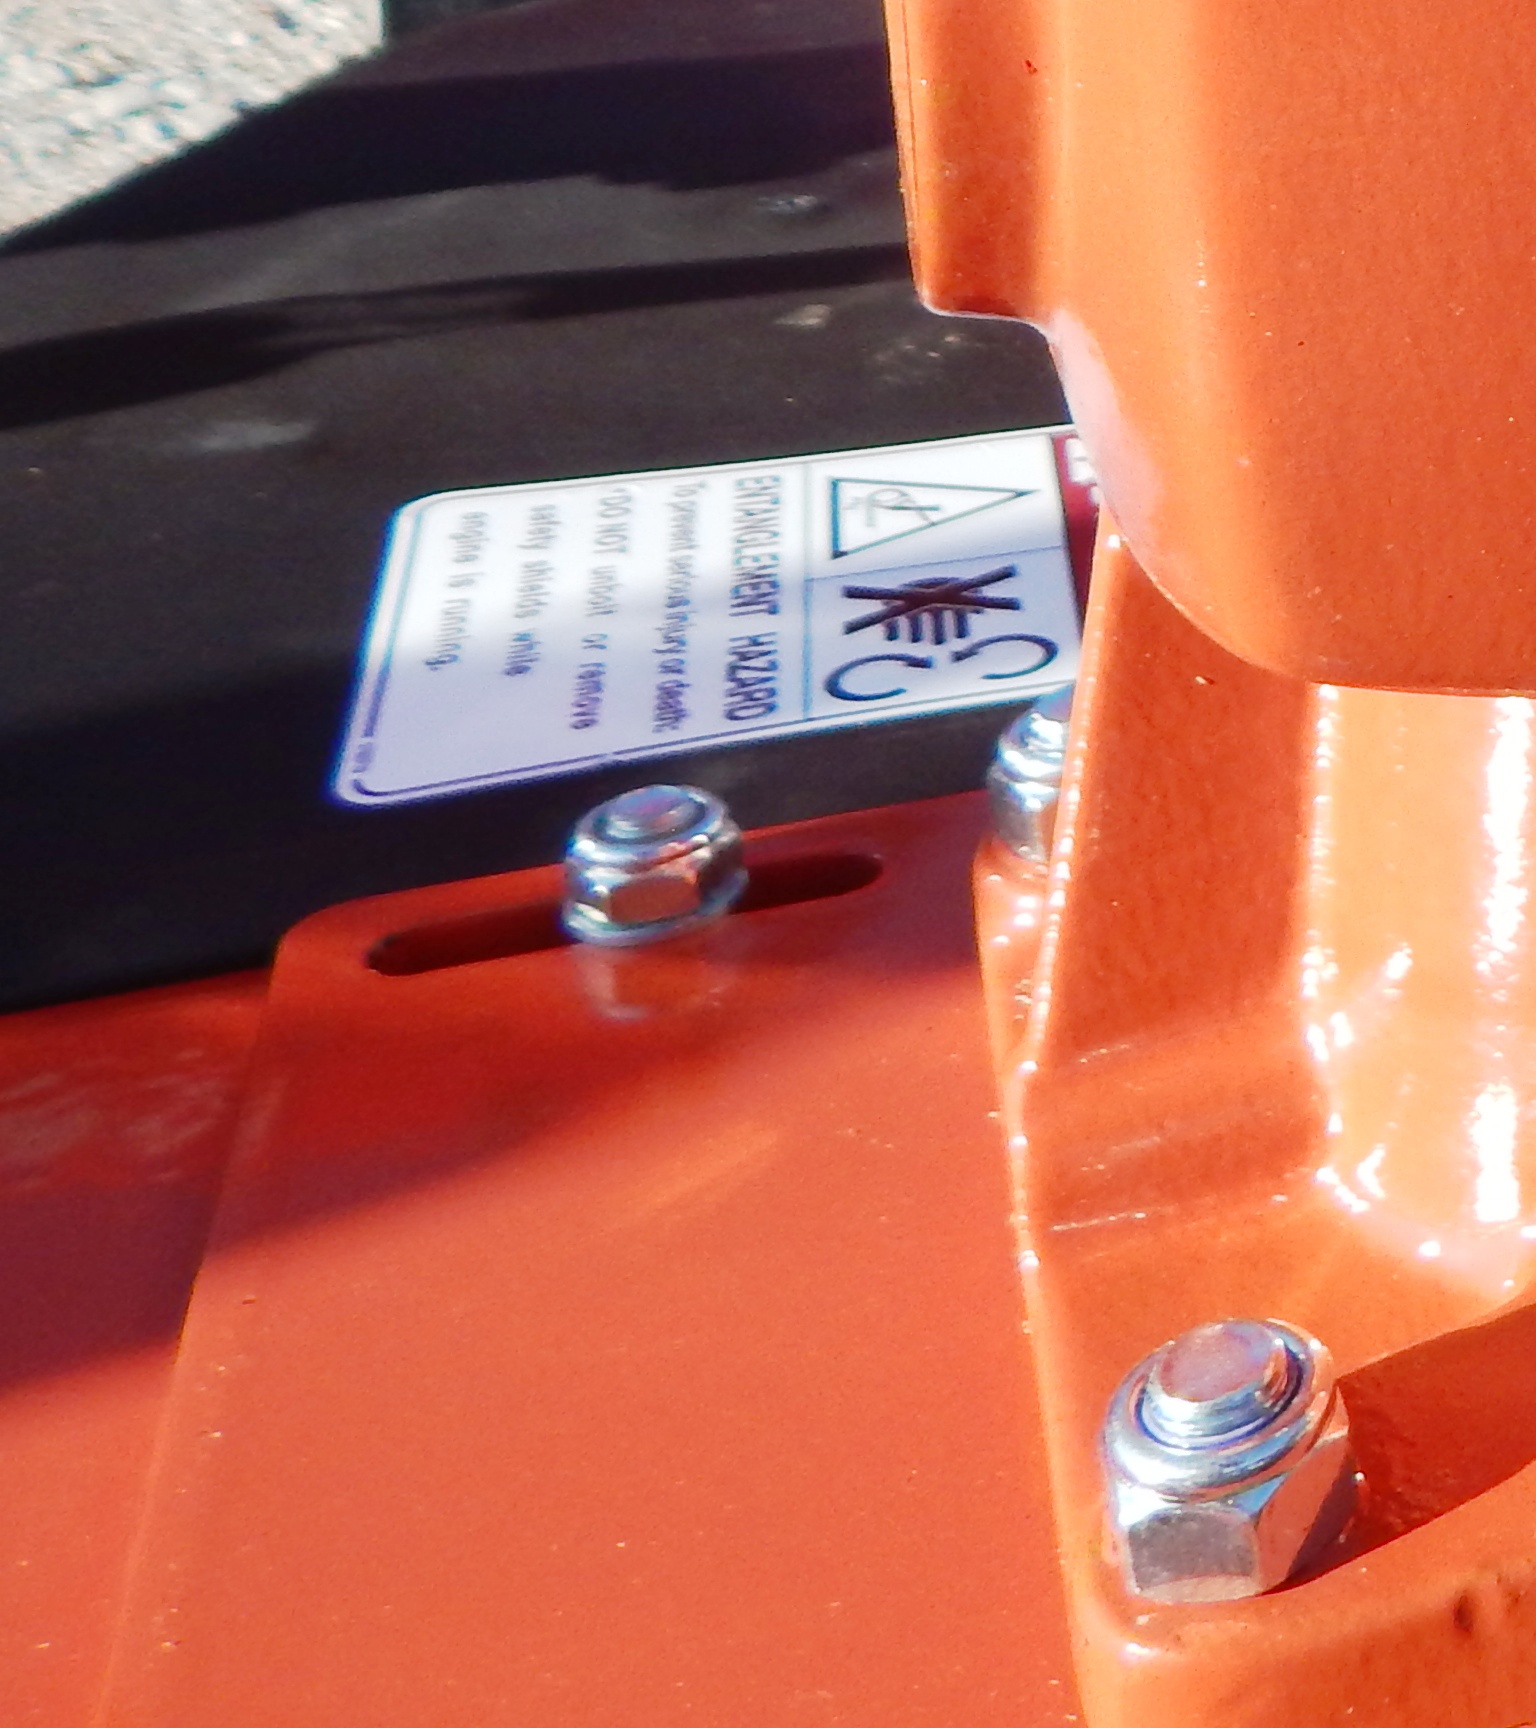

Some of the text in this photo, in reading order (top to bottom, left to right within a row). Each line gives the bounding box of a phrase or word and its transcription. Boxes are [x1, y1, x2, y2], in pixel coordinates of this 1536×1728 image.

[673, 480, 708, 498] To
[449, 511, 491, 563] engine
[592, 522, 630, 554] NOT
[664, 500, 700, 553] prevent
[448, 572, 486, 588] is
[504, 503, 562, 677] safety shields while
[584, 564, 624, 618] unbolt
[664, 555, 699, 609] serious
[724, 475, 781, 722] ENTANGLEMENT HAZARD
[580, 633, 609, 650] or
[652, 610, 698, 653] injury
[656, 657, 688, 675] or
[569, 662, 607, 730] remove
